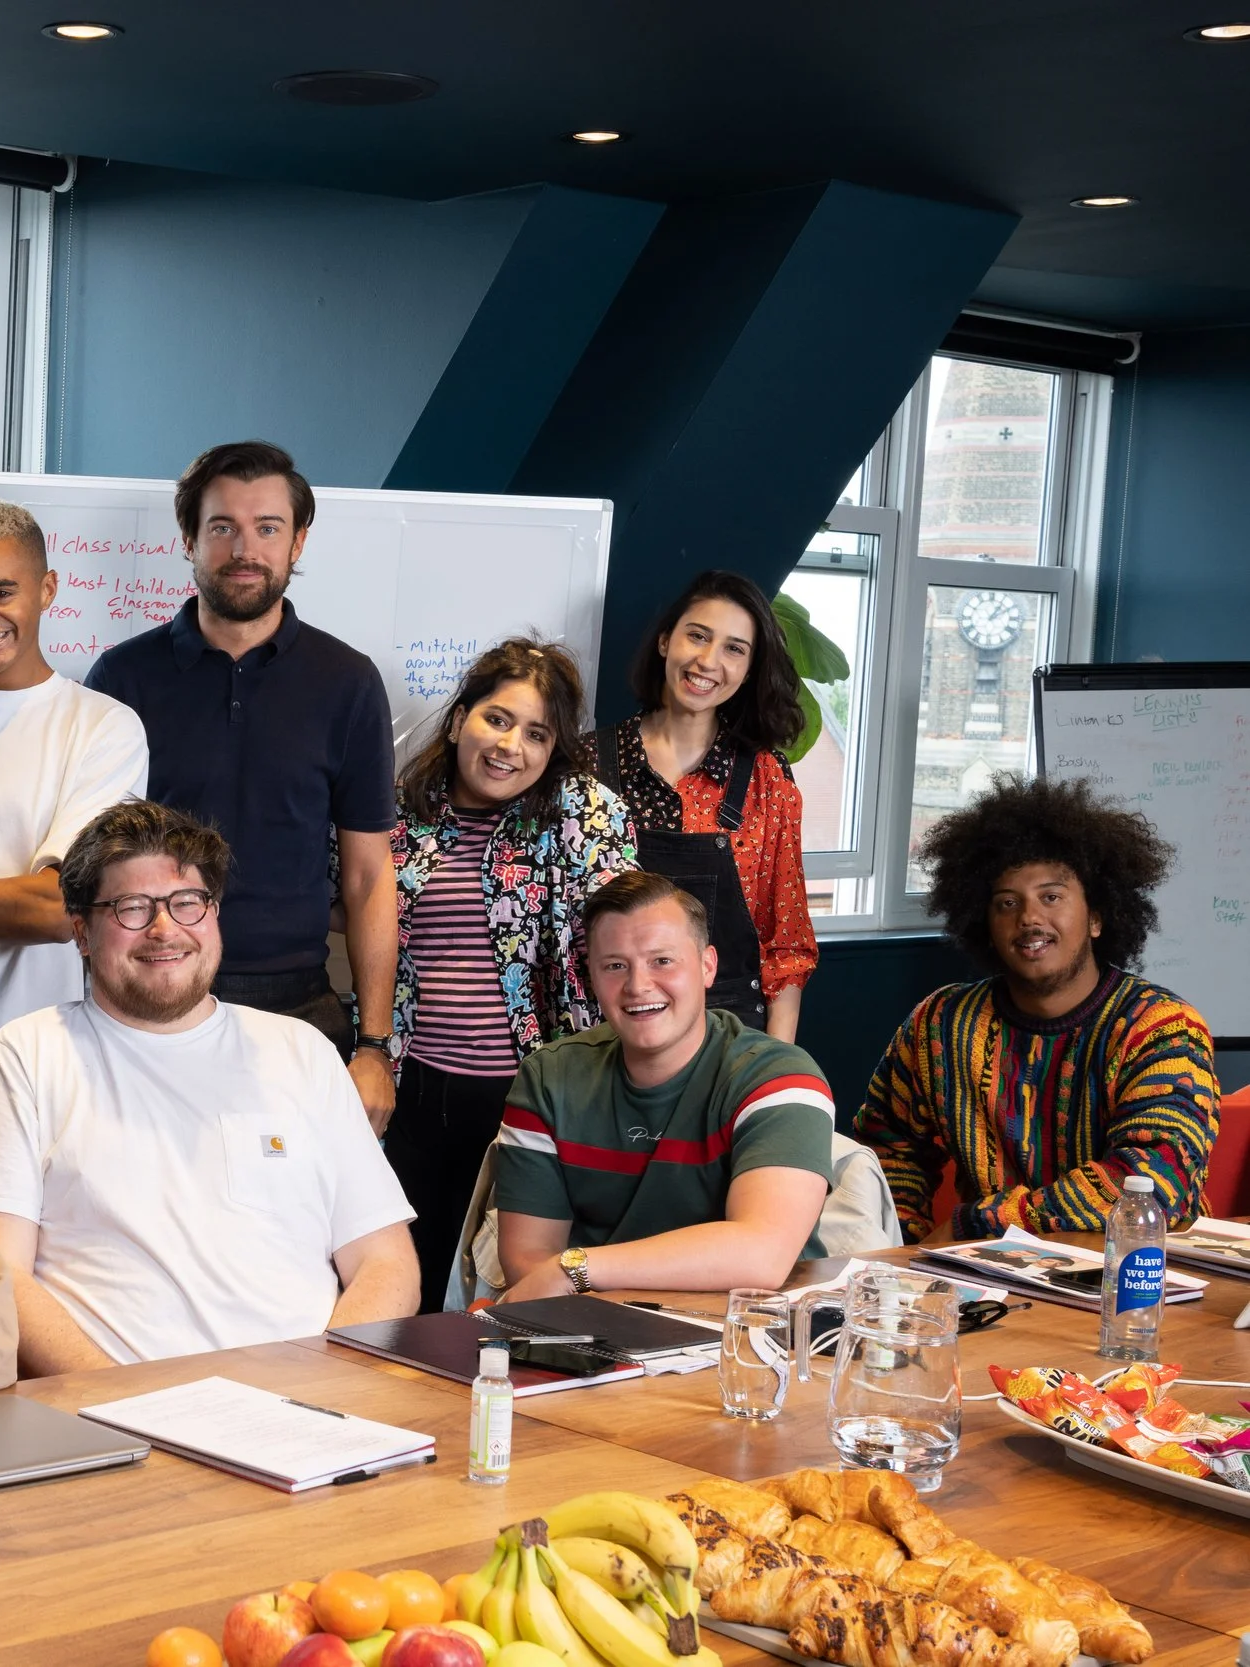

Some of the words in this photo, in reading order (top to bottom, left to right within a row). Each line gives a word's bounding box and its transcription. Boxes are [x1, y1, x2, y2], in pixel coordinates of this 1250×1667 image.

[62, 535, 112, 555] class
[119, 538, 177, 555] visual
[67, 572, 108, 591] least
[125, 577, 164, 595] child
[167, 581, 199, 596] outs
[110, 608, 133, 620] for
[410, 638, 477, 654] Mitchell
[405, 656, 447, 669] around
[405, 671, 425, 684] the
[1134, 1255, 1162, 1267] have
[1125, 1268, 1146, 1279] we
